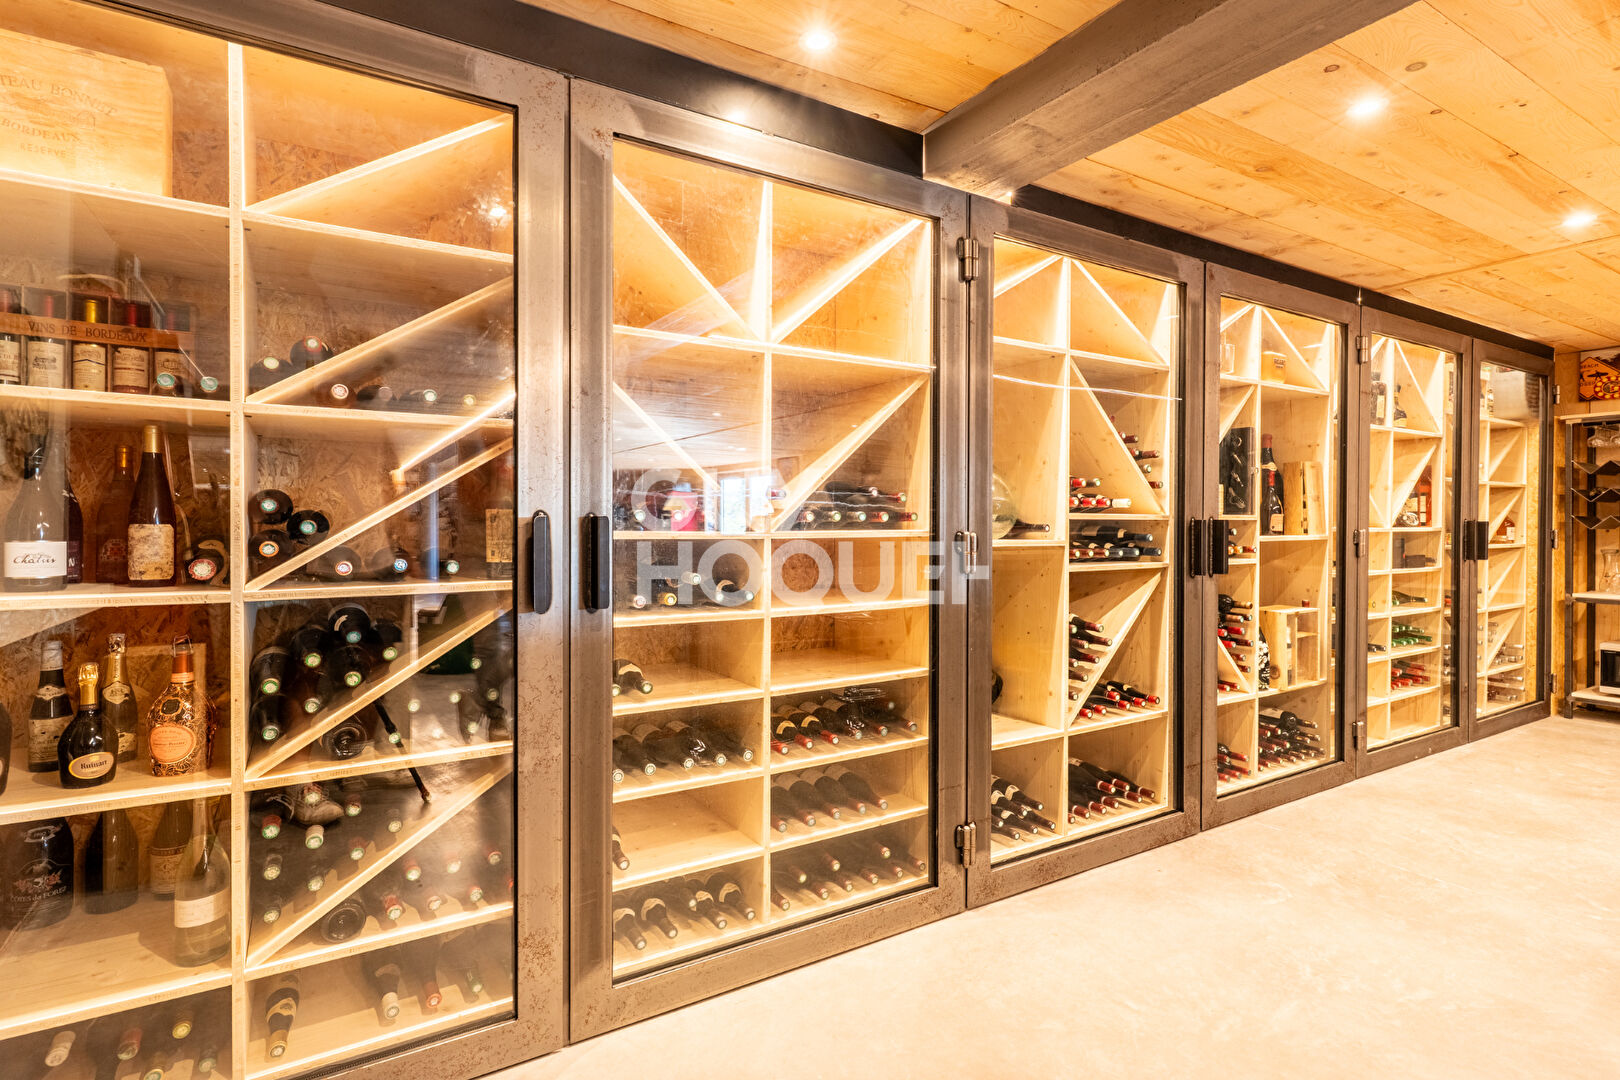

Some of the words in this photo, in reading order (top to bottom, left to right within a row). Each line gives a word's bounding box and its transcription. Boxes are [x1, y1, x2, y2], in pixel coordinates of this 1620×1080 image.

[51, 83, 118, 117] BONNET
[1, 117, 81, 143] BORDEAUX
[28, 321, 56, 334] VINS
[61, 325, 77, 337] DE
[85, 326, 147, 343] BORDEAUX
